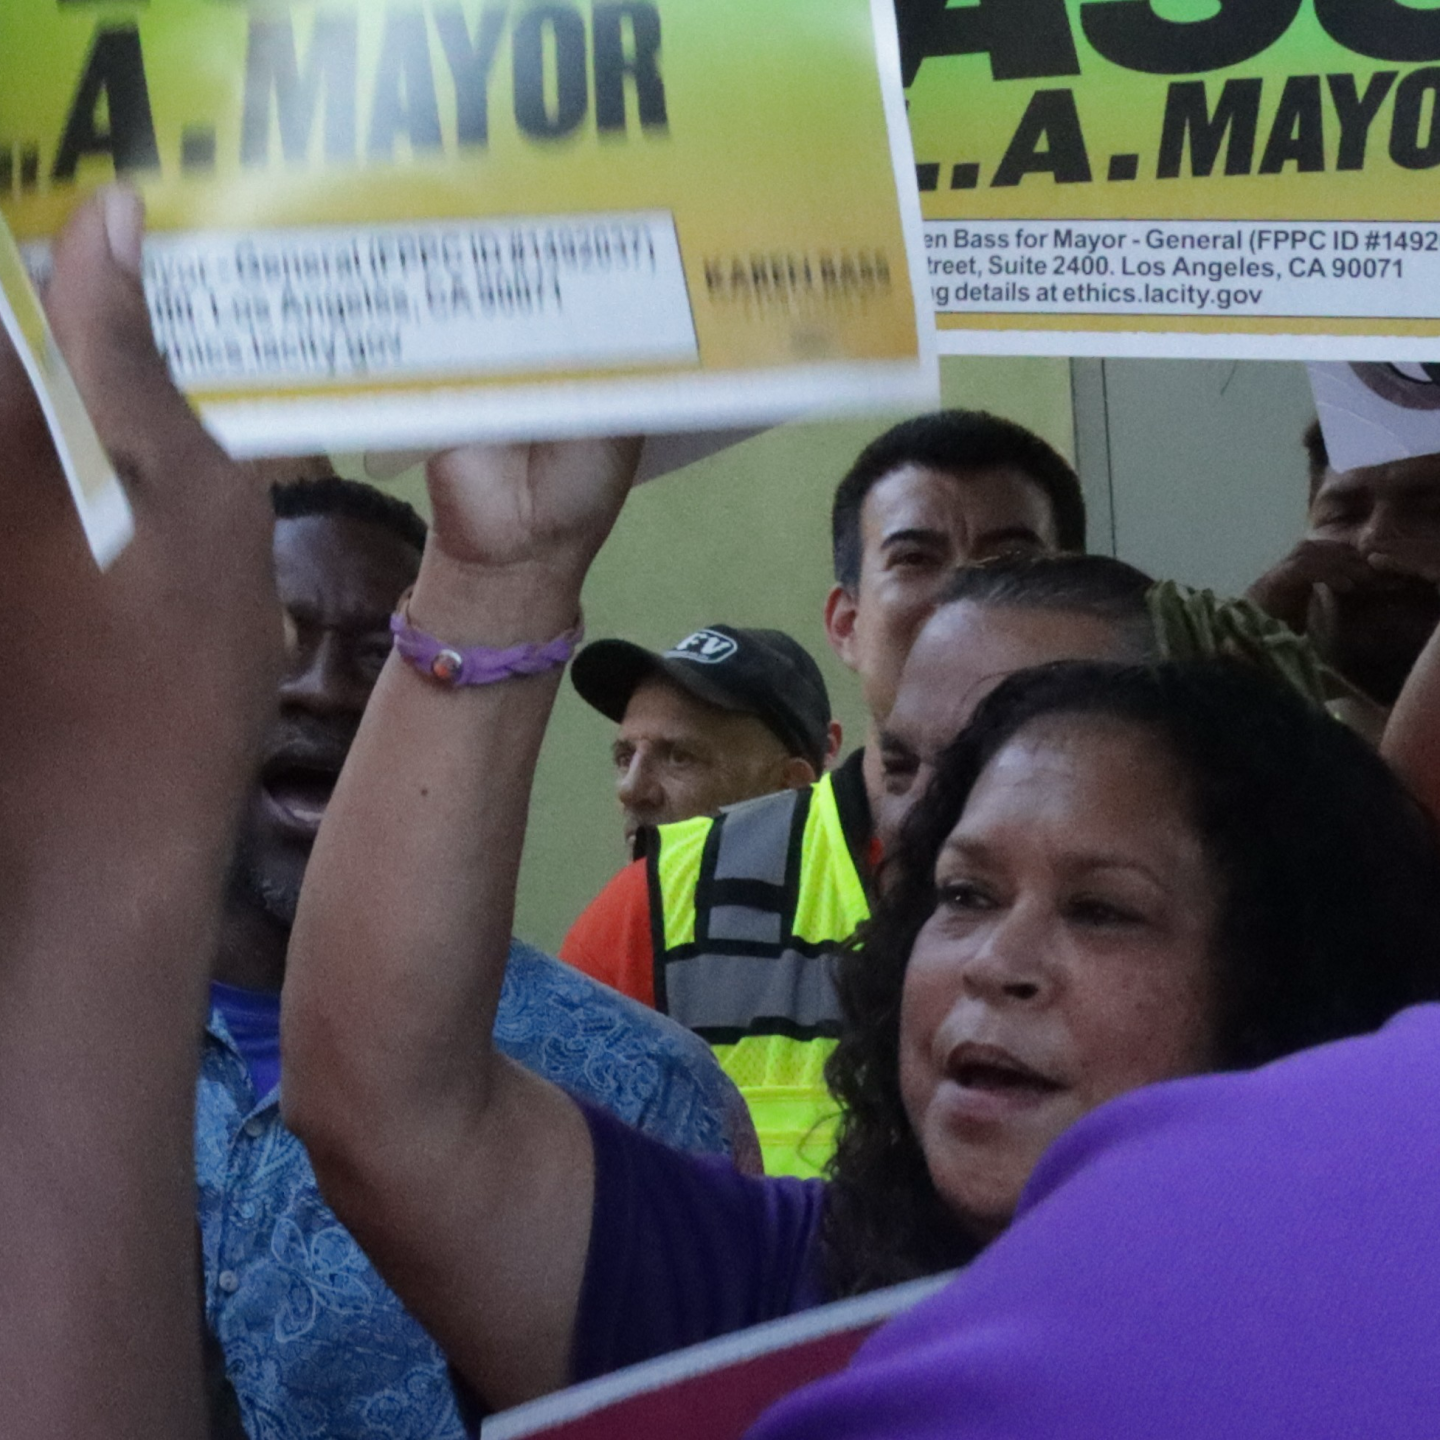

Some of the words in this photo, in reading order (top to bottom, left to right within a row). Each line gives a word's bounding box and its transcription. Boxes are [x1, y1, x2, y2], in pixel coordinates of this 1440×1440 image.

[954, 229, 1009, 249] Bass
[1016, 228, 1048, 248] for
[1054, 228, 1127, 254] Mayor
[1145, 229, 1242, 251] General
[1249, 229, 1327, 254] (FPPC
[1333, 230, 1359, 251] ID
[1365, 230, 1439, 252] #1492
[988, 255, 1047, 275] Suite
[1053, 256, 1115, 276] 2400.
[1121, 256, 1165, 276] Los
[1173, 256, 1281, 281] Angeles,
[1288, 257, 1326, 278] CA
[1332, 257, 1403, 279] 90071
[955, 282, 1030, 302] details
[1036, 284, 1057, 302] at
[1063, 281, 1263, 309] ethics.lacity.gov
